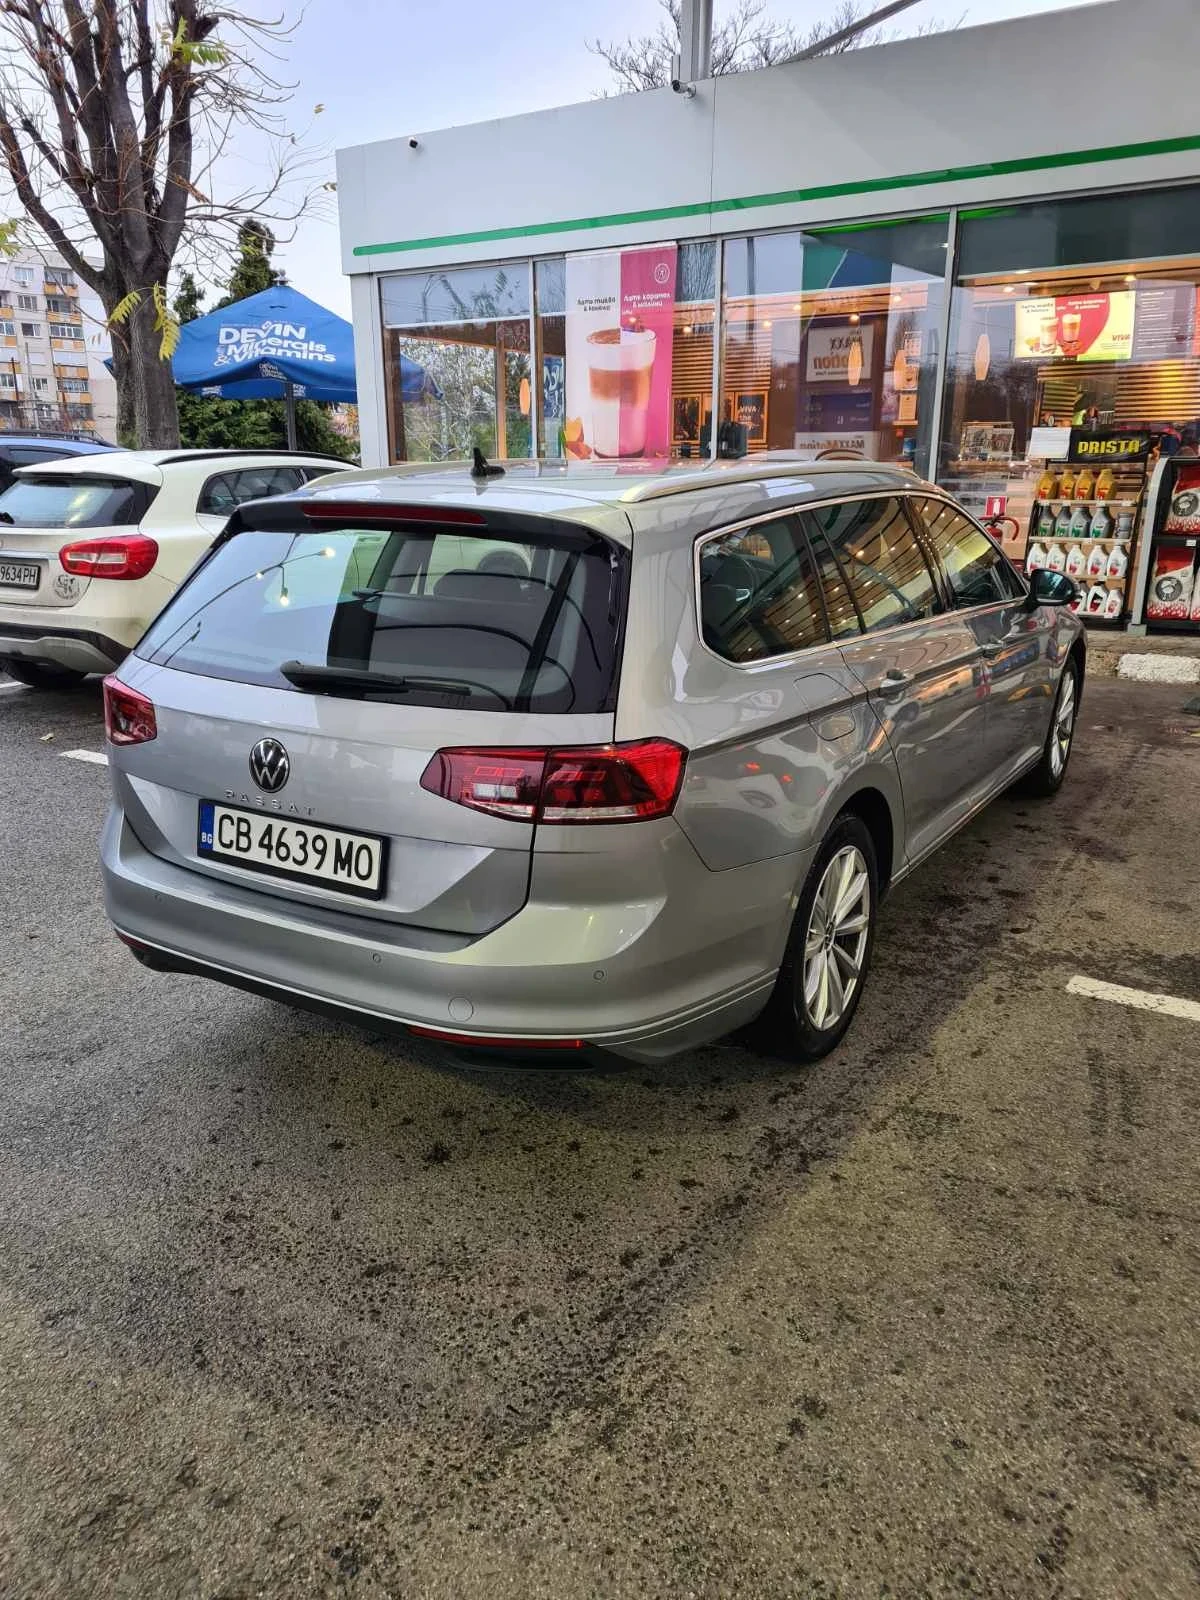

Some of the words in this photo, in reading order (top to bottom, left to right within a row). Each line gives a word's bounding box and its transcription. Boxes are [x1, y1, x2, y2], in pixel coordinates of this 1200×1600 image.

[219, 323, 306, 344] DEVIN
[227, 338, 327, 356] Minerals
[232, 347, 337, 362] Vitamins
[1078, 440, 1140, 454] PRISTA
[224, 789, 315, 816] PASSAT
[201, 832, 212, 844] BG
